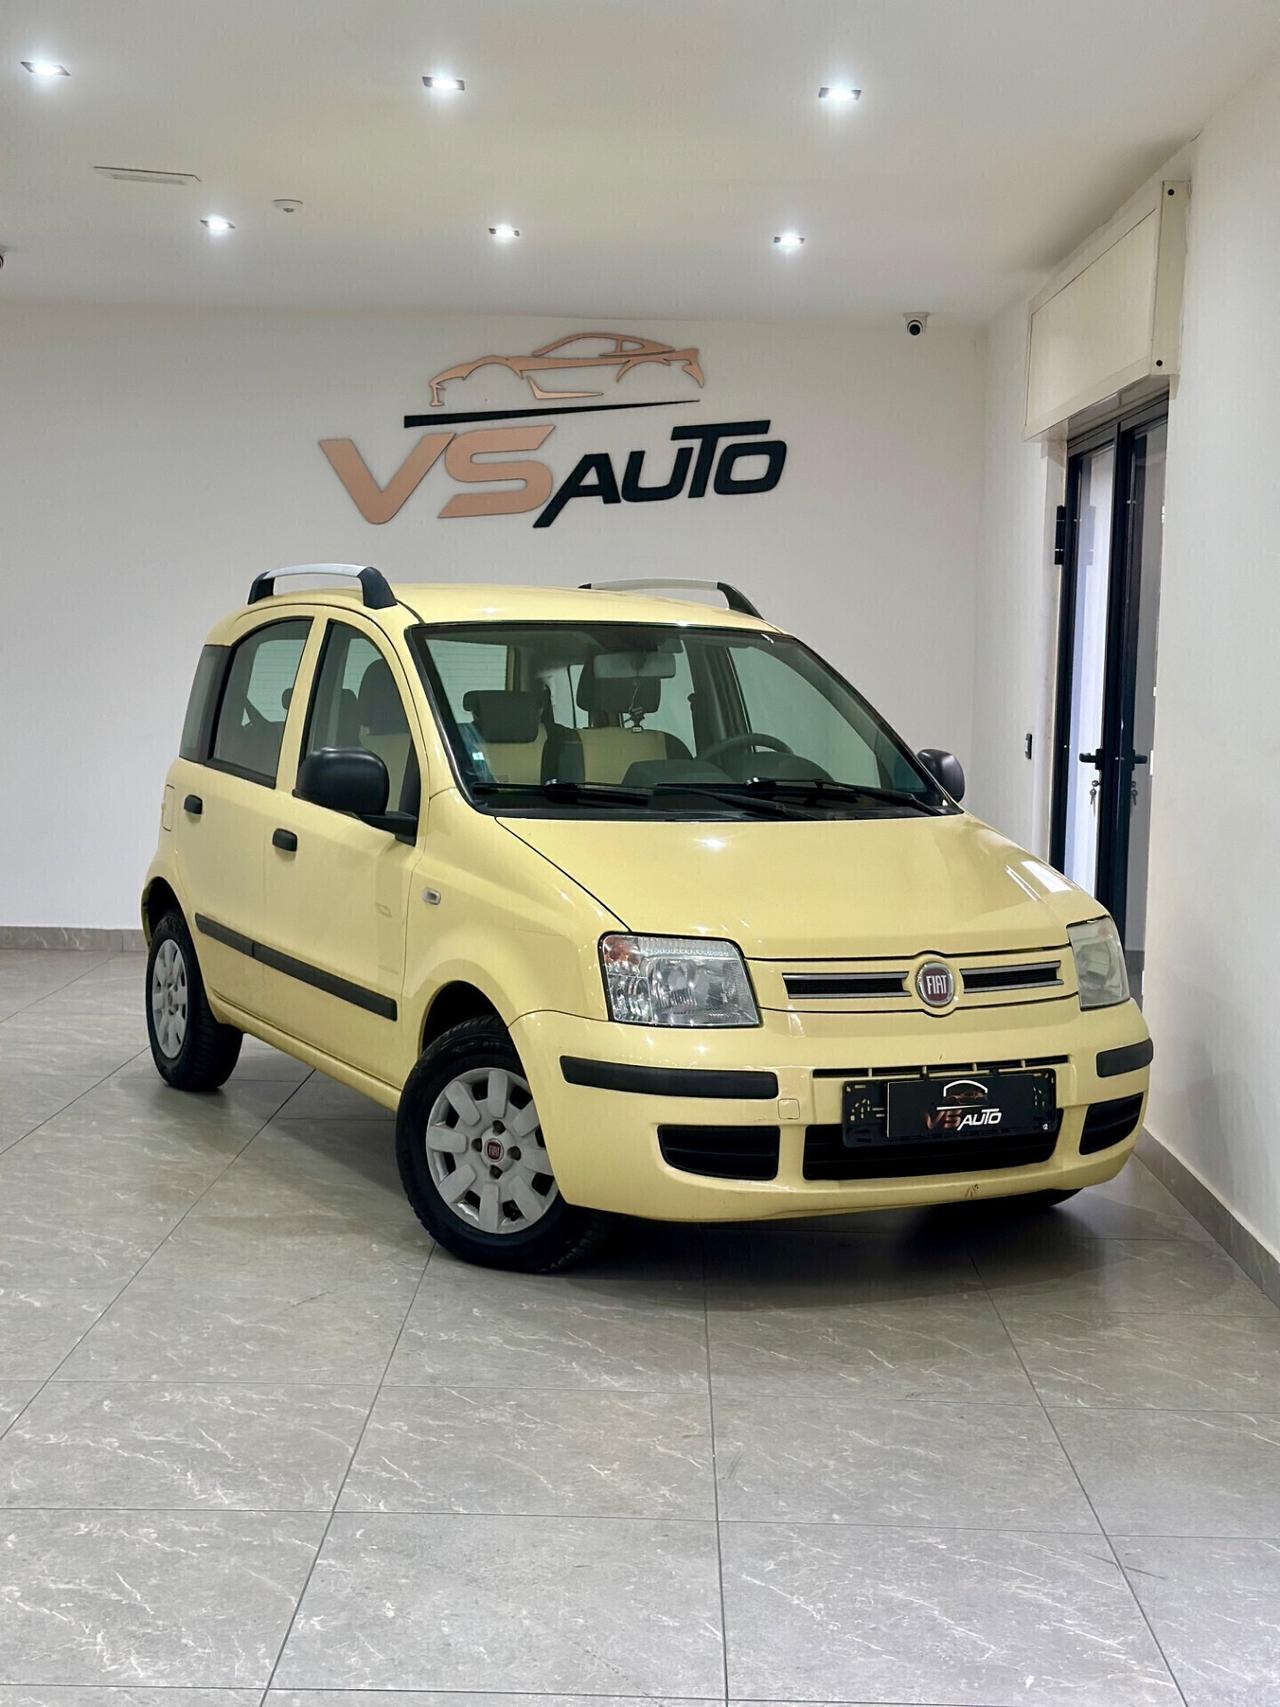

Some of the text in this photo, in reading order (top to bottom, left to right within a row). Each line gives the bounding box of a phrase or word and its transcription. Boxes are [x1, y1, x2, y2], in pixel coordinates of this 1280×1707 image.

[318, 419, 787, 528] VS AUTO
[925, 975, 947, 995] FIAT
[957, 1108, 1002, 1131] AUTO
